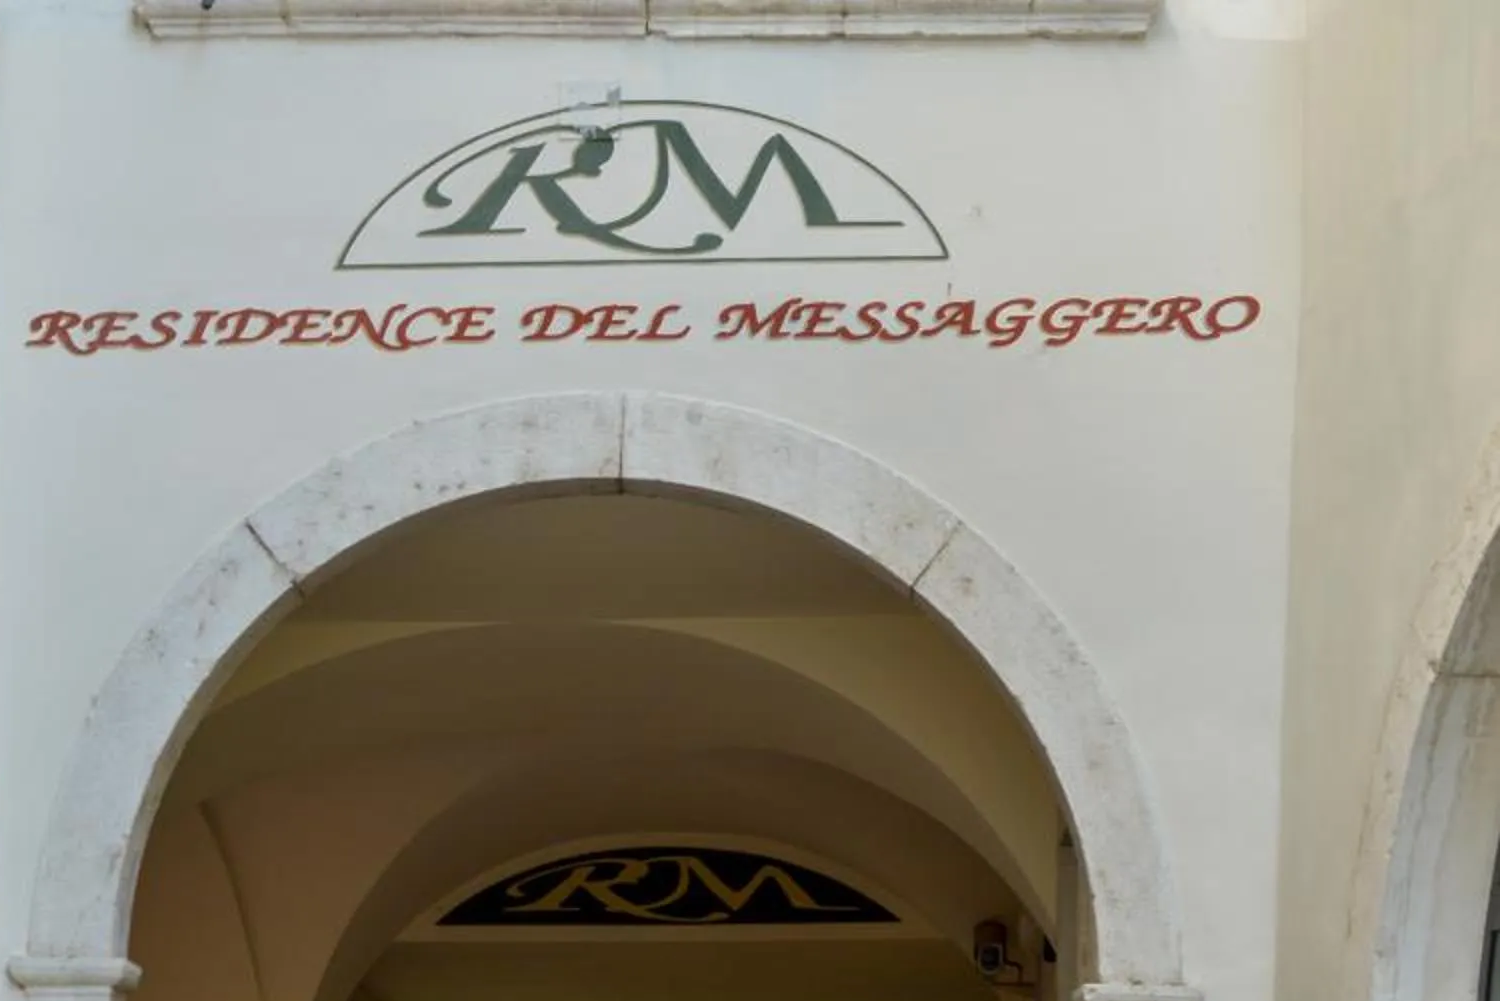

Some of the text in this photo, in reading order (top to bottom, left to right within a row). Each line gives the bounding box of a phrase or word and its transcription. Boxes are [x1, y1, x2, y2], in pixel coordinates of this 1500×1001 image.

[25, 295, 1261, 356] RESIDENCE DEL MESSAGGERO
